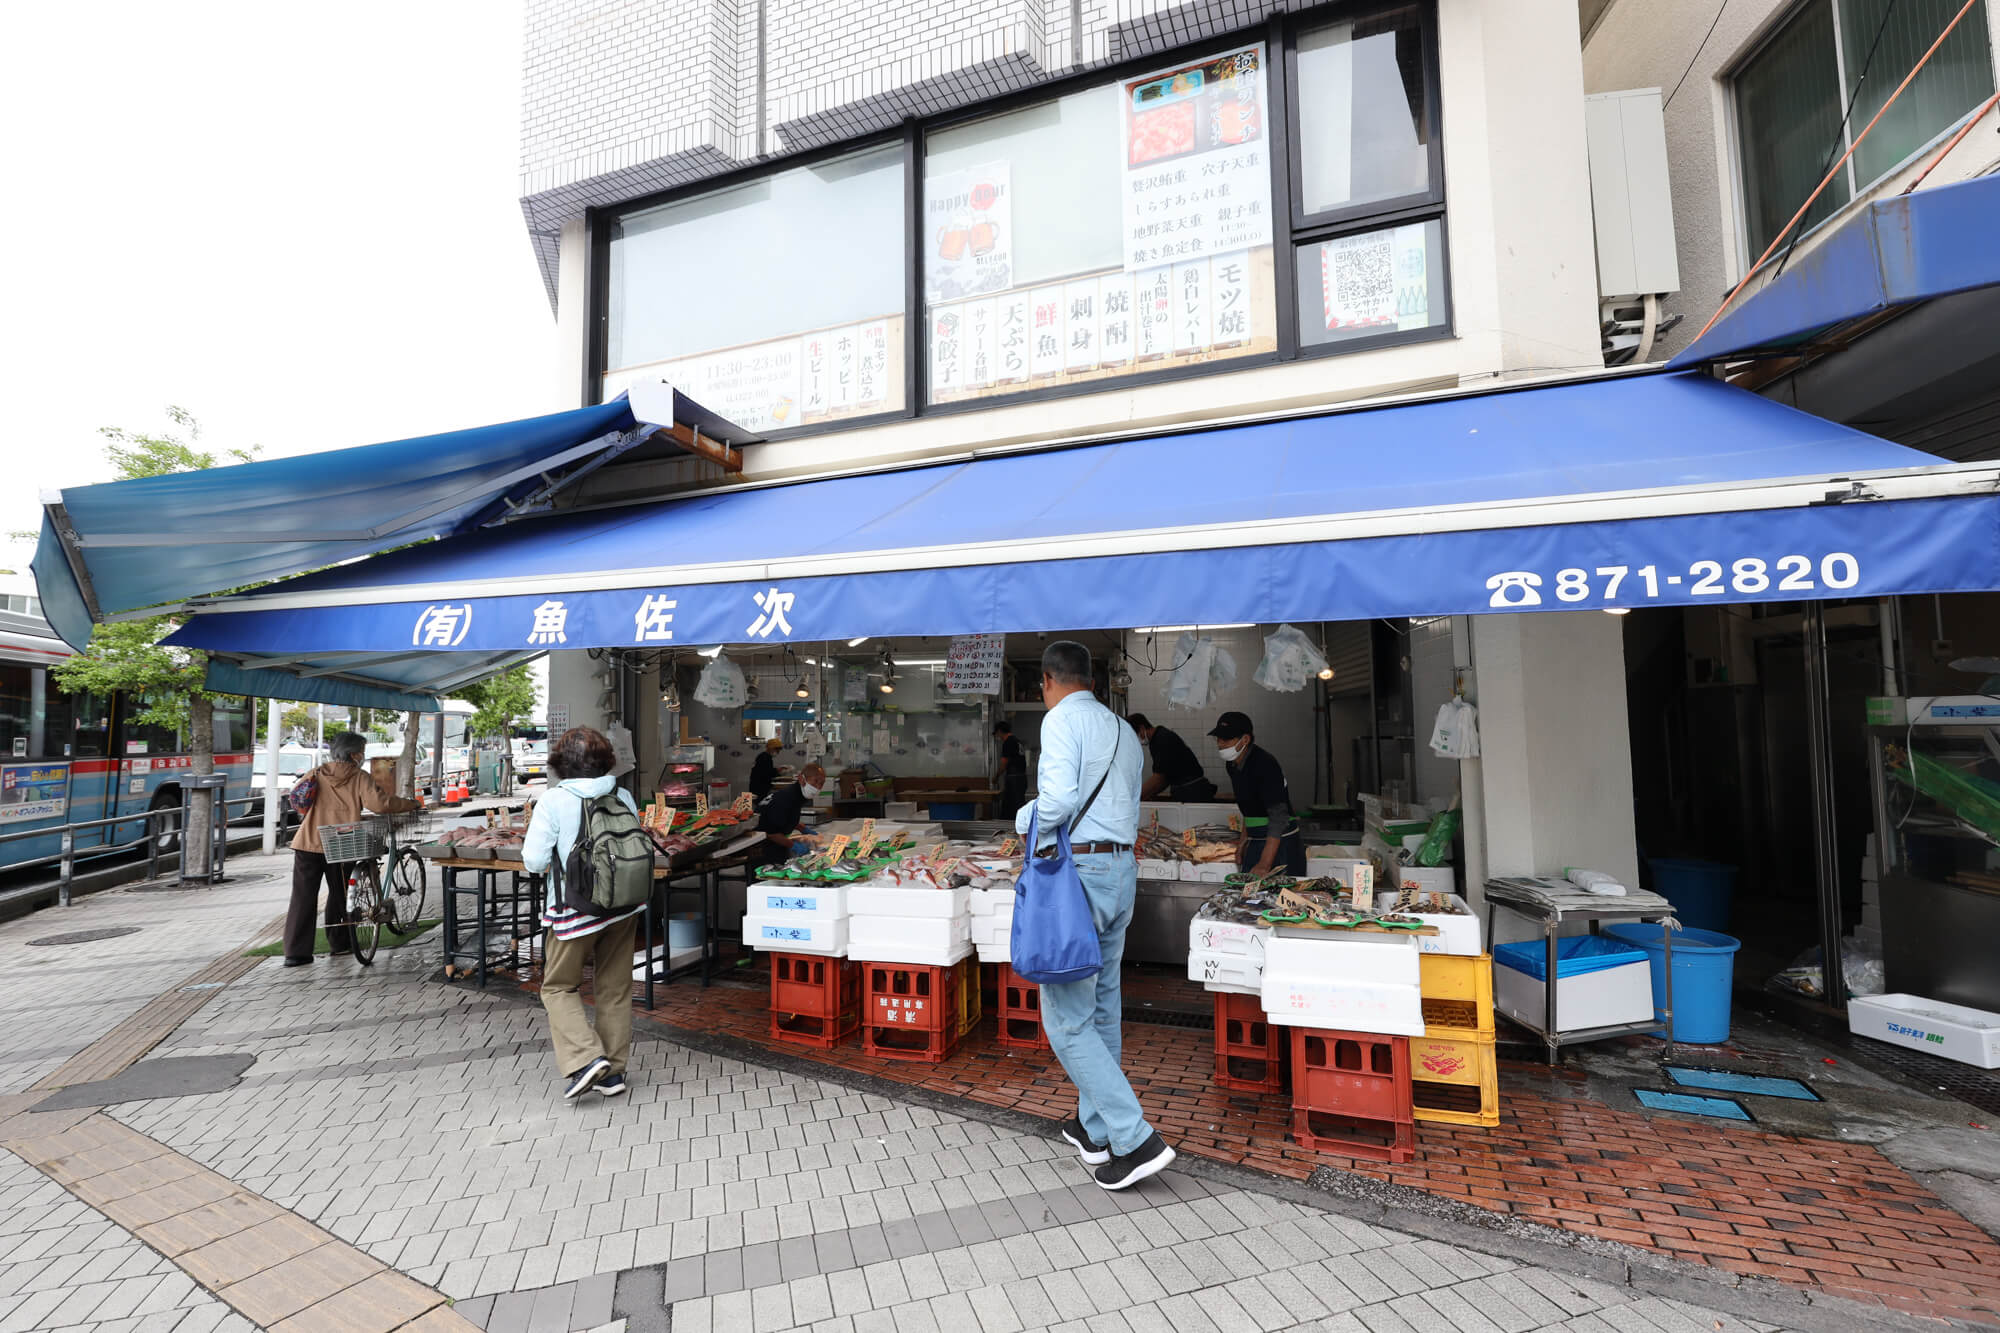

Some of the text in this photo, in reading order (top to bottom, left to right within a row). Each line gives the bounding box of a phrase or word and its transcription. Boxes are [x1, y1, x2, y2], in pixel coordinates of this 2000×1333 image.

[1070, 295, 1093, 351] 刺身
[1105, 290, 1129, 346] 焼酎
[1218, 263, 1246, 336] モツ焼
[1002, 302, 1025, 372] 天ぷら
[1035, 301, 1059, 359] 鮮魚
[809, 340, 822, 405] 生ビール
[860, 355, 873, 400] 煮込み
[1555, 552, 1860, 602] 871-2820
